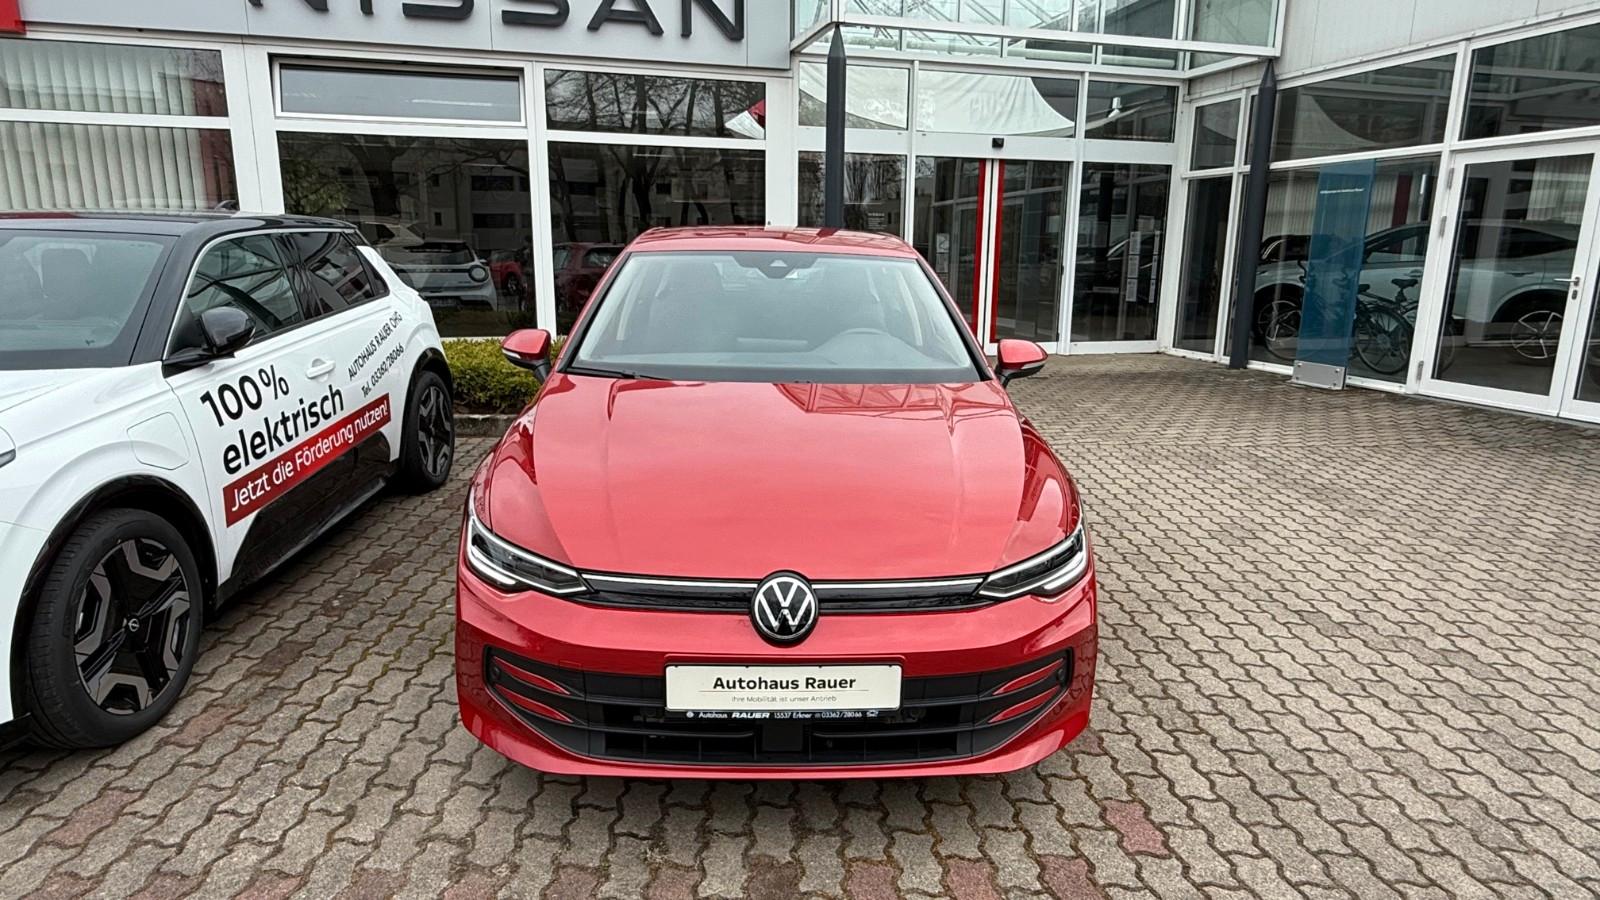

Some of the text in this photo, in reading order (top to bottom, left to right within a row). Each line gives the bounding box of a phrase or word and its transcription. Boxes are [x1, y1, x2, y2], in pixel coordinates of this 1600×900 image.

[347, 311, 403, 381] AUTOHAUS RAUER OHG
[200, 364, 289, 427] 100%
[222, 384, 344, 475] elektrisch
[231, 402, 389, 512] Jetzt die Förderung nutzen!
[698, 711, 729, 719] Autohaus
[713, 676, 856, 690] Autohaus Rauer
